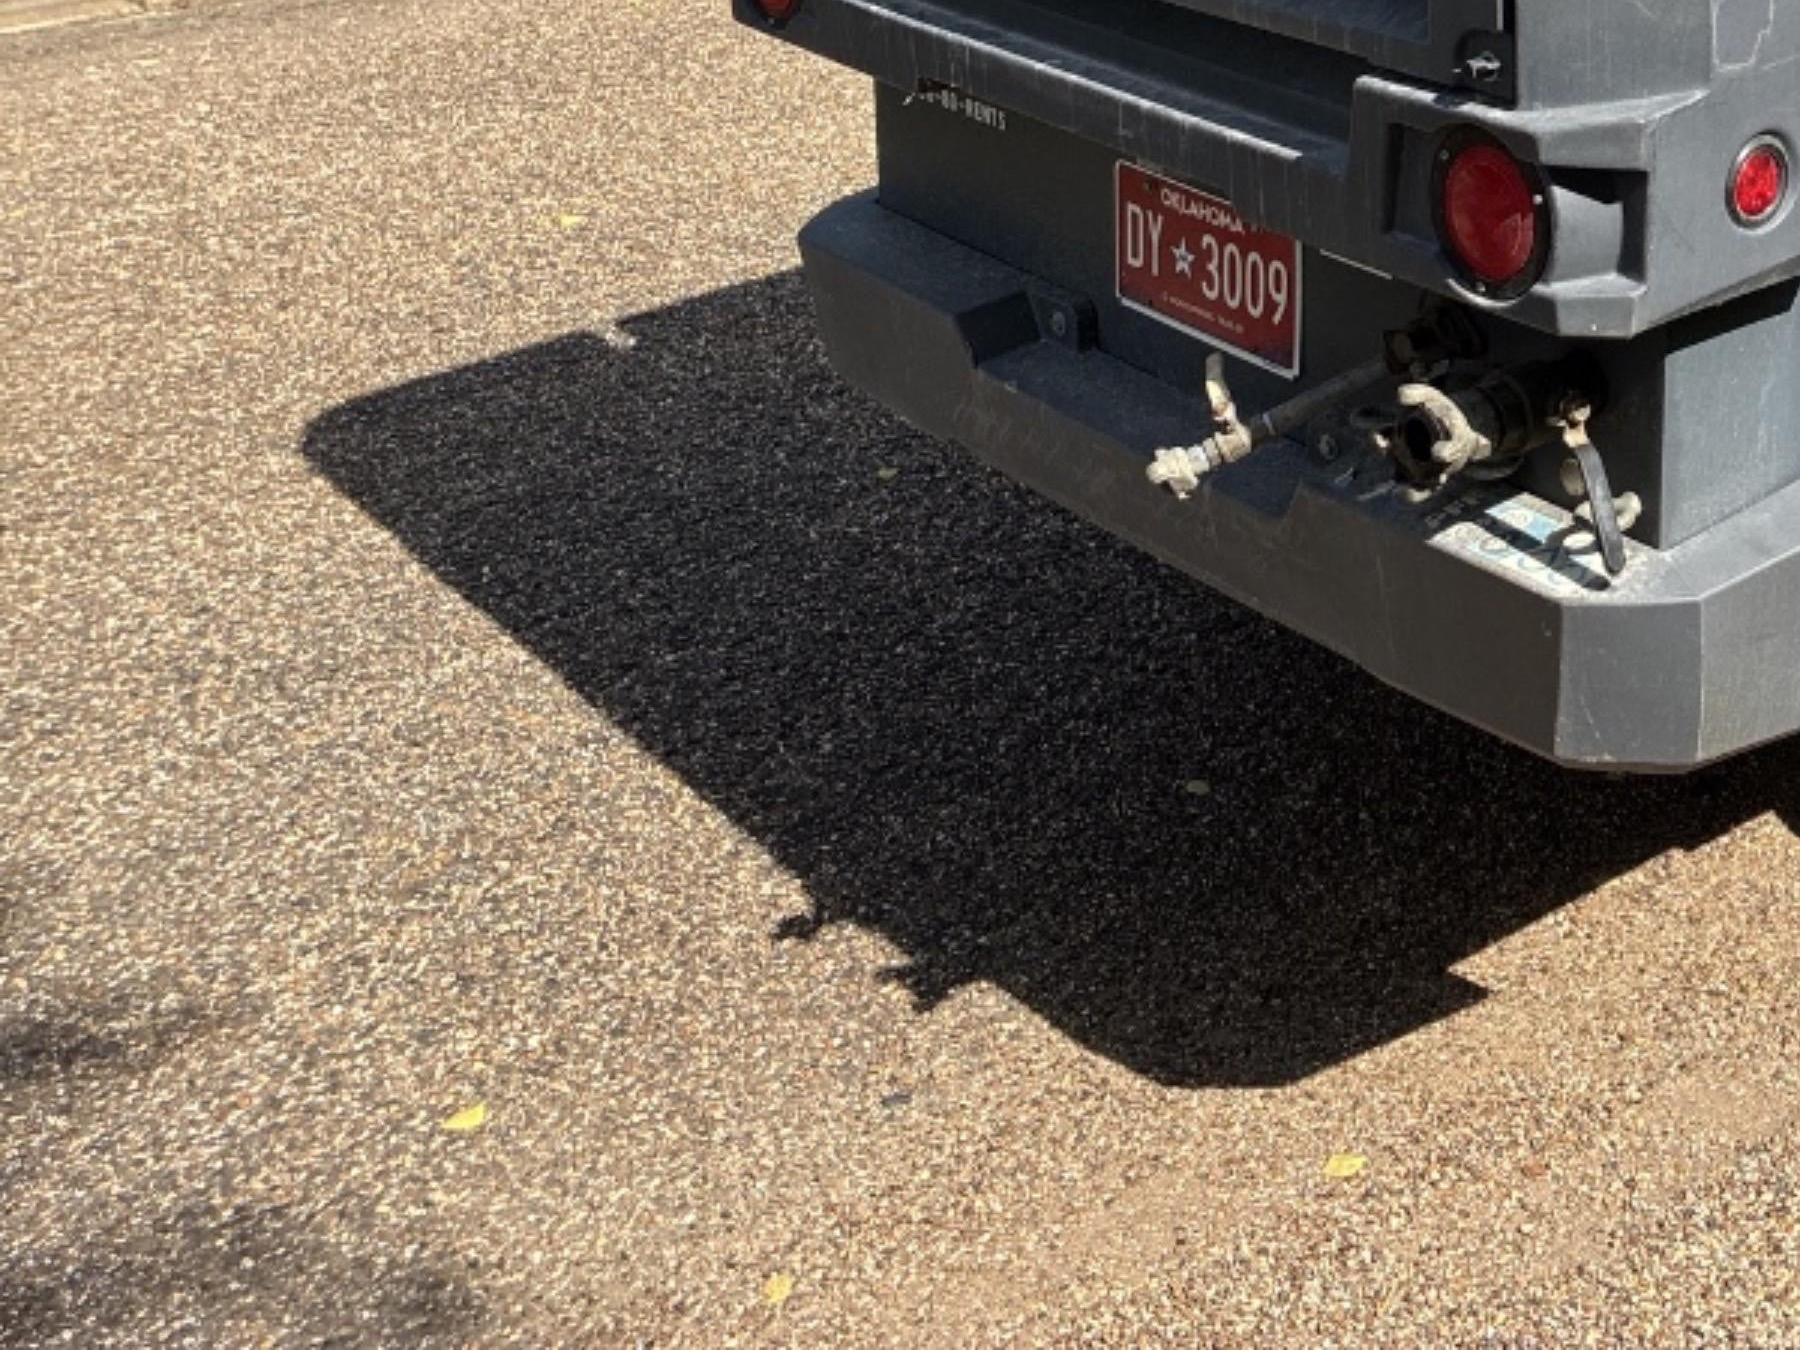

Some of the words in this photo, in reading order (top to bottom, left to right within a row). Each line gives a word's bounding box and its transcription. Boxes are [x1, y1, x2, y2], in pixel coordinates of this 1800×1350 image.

[1159, 187, 1246, 235] OKLAHOMA
[1126, 202, 1164, 278] DY
[1201, 233, 1289, 326] 3009
